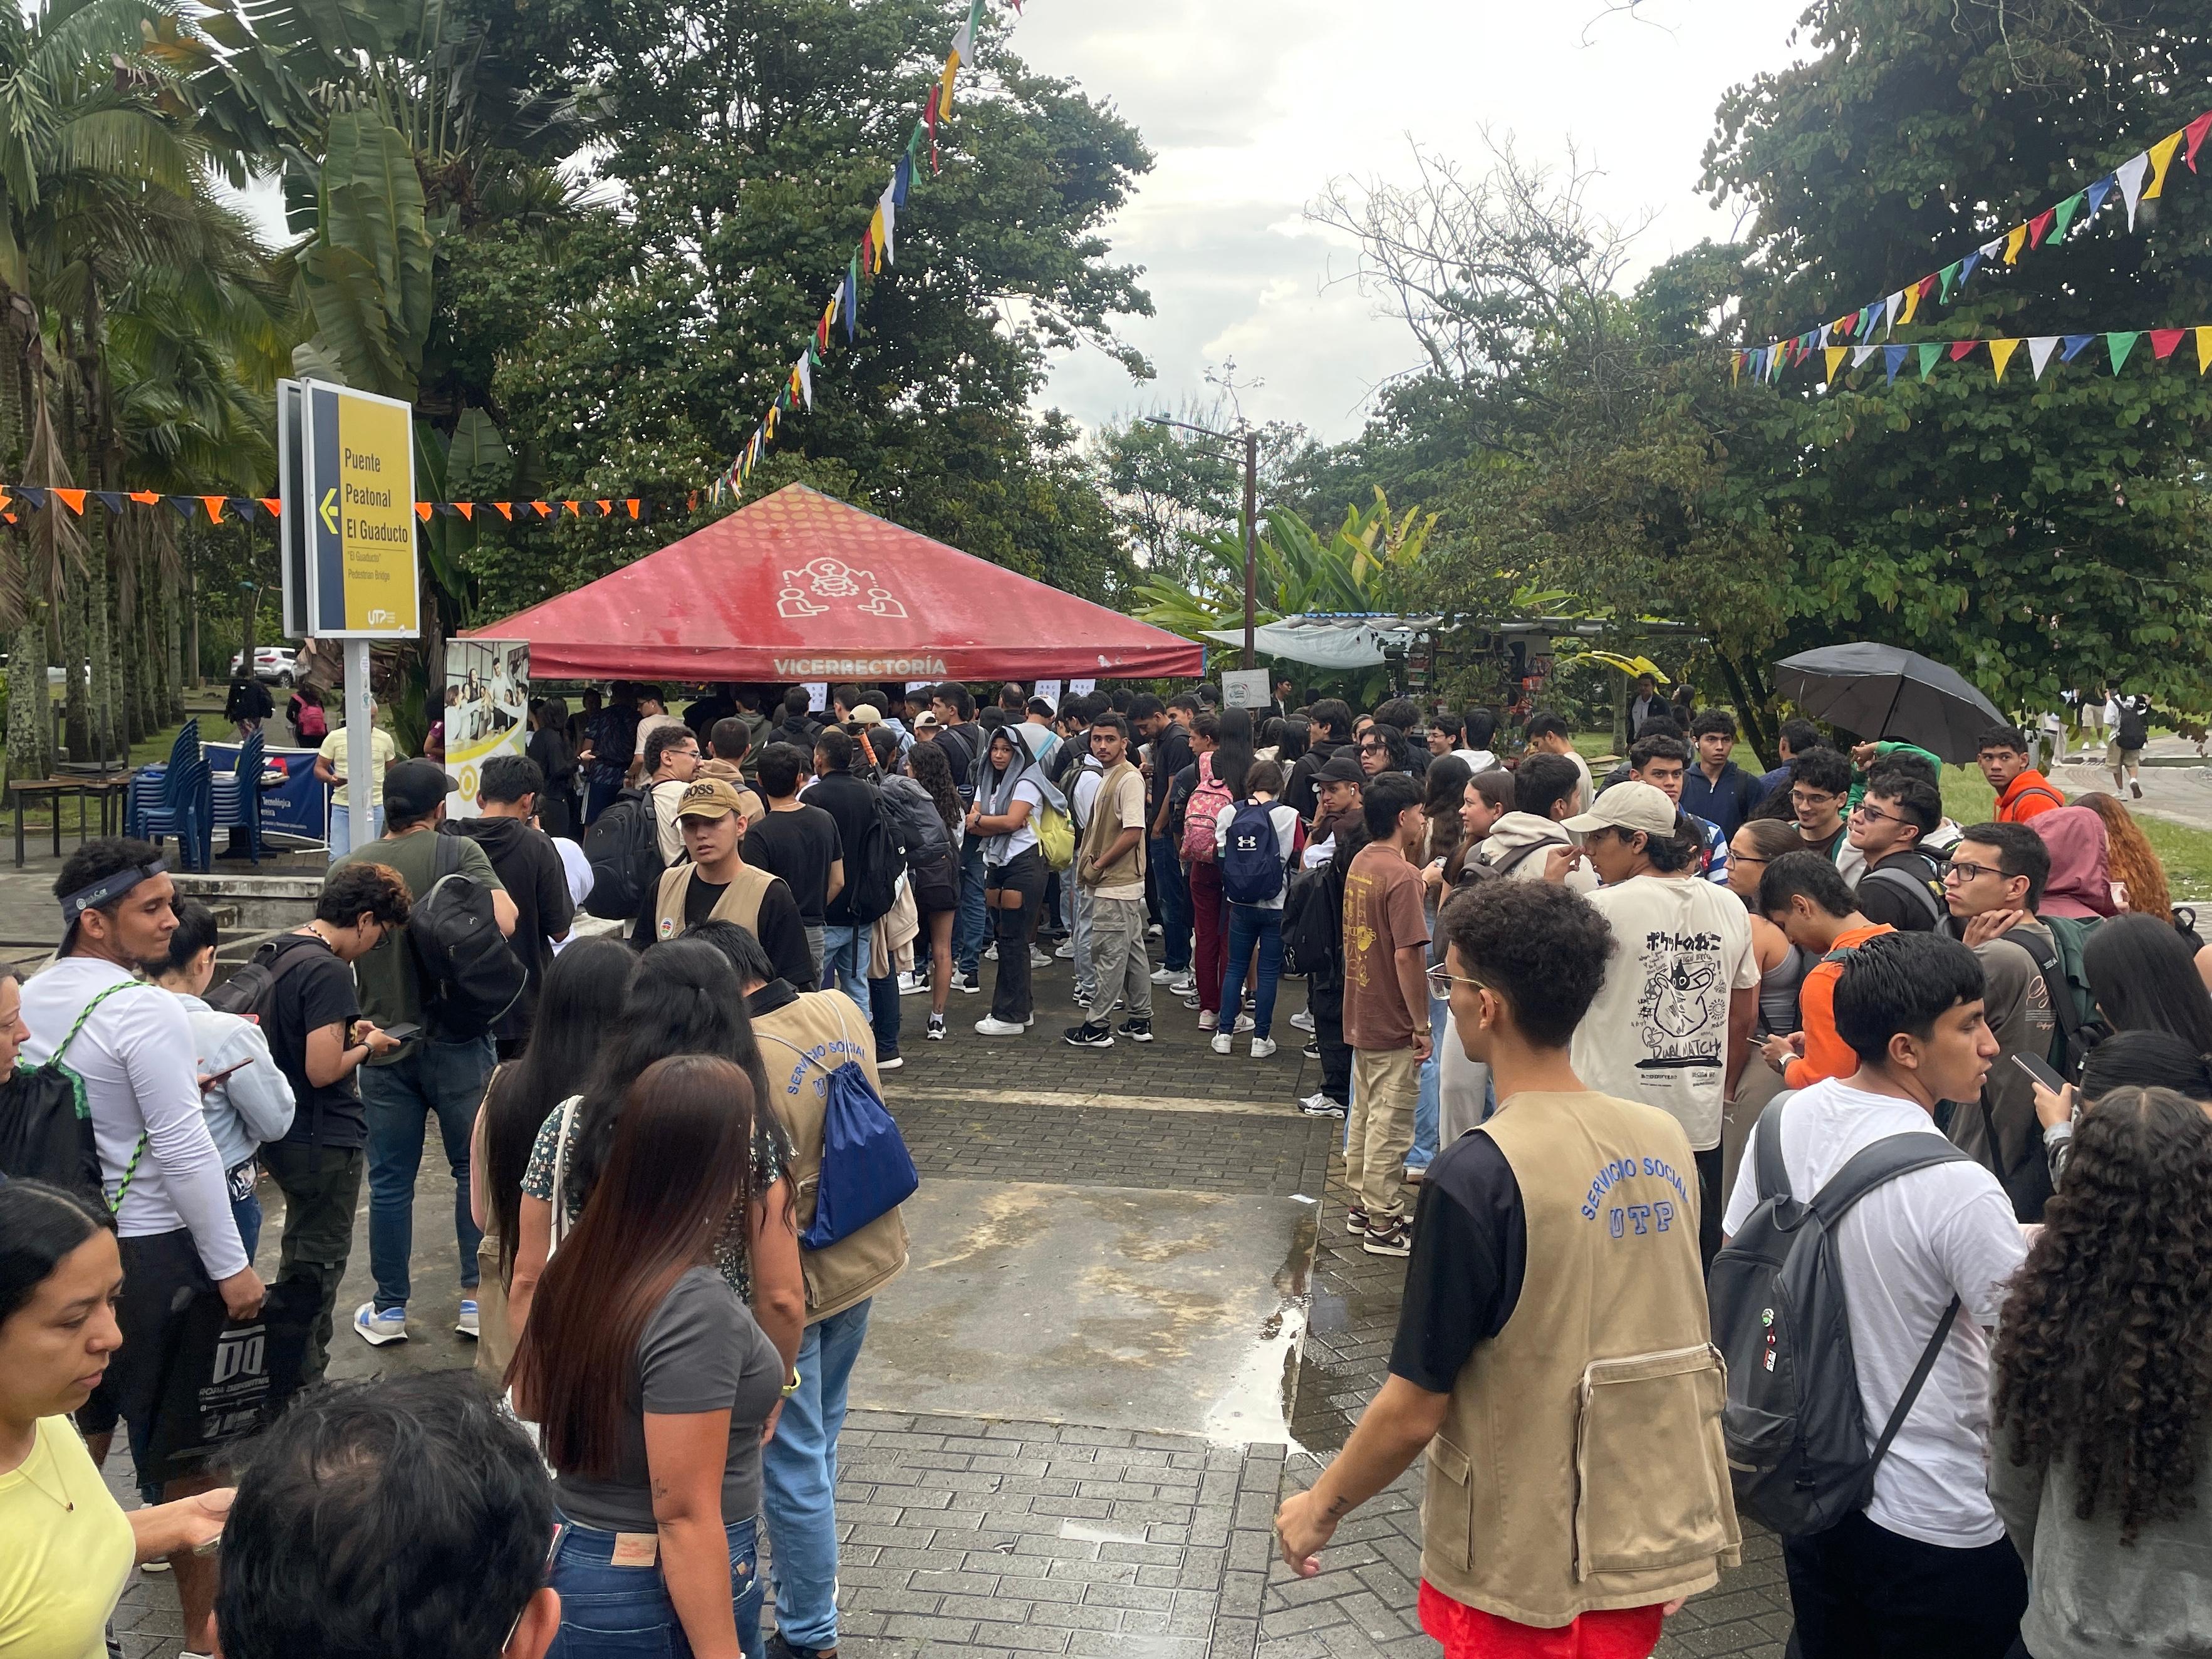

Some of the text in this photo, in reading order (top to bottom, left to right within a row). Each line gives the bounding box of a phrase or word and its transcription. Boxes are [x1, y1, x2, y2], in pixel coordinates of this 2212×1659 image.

[345, 447, 380, 472] Puente
[346, 483, 391, 507] Peatonal
[346, 518, 408, 543] El Guaducto
[348, 568, 390, 582] Pedestrian Bridge
[368, 609, 387, 626] UTP
[774, 655, 947, 675] VICERRECTORÍA
[682, 784, 714, 799] BOSS
[1581, 1158, 1688, 1220] SERVICIO SOCIAL
[1610, 1201, 1674, 1238] UTP
